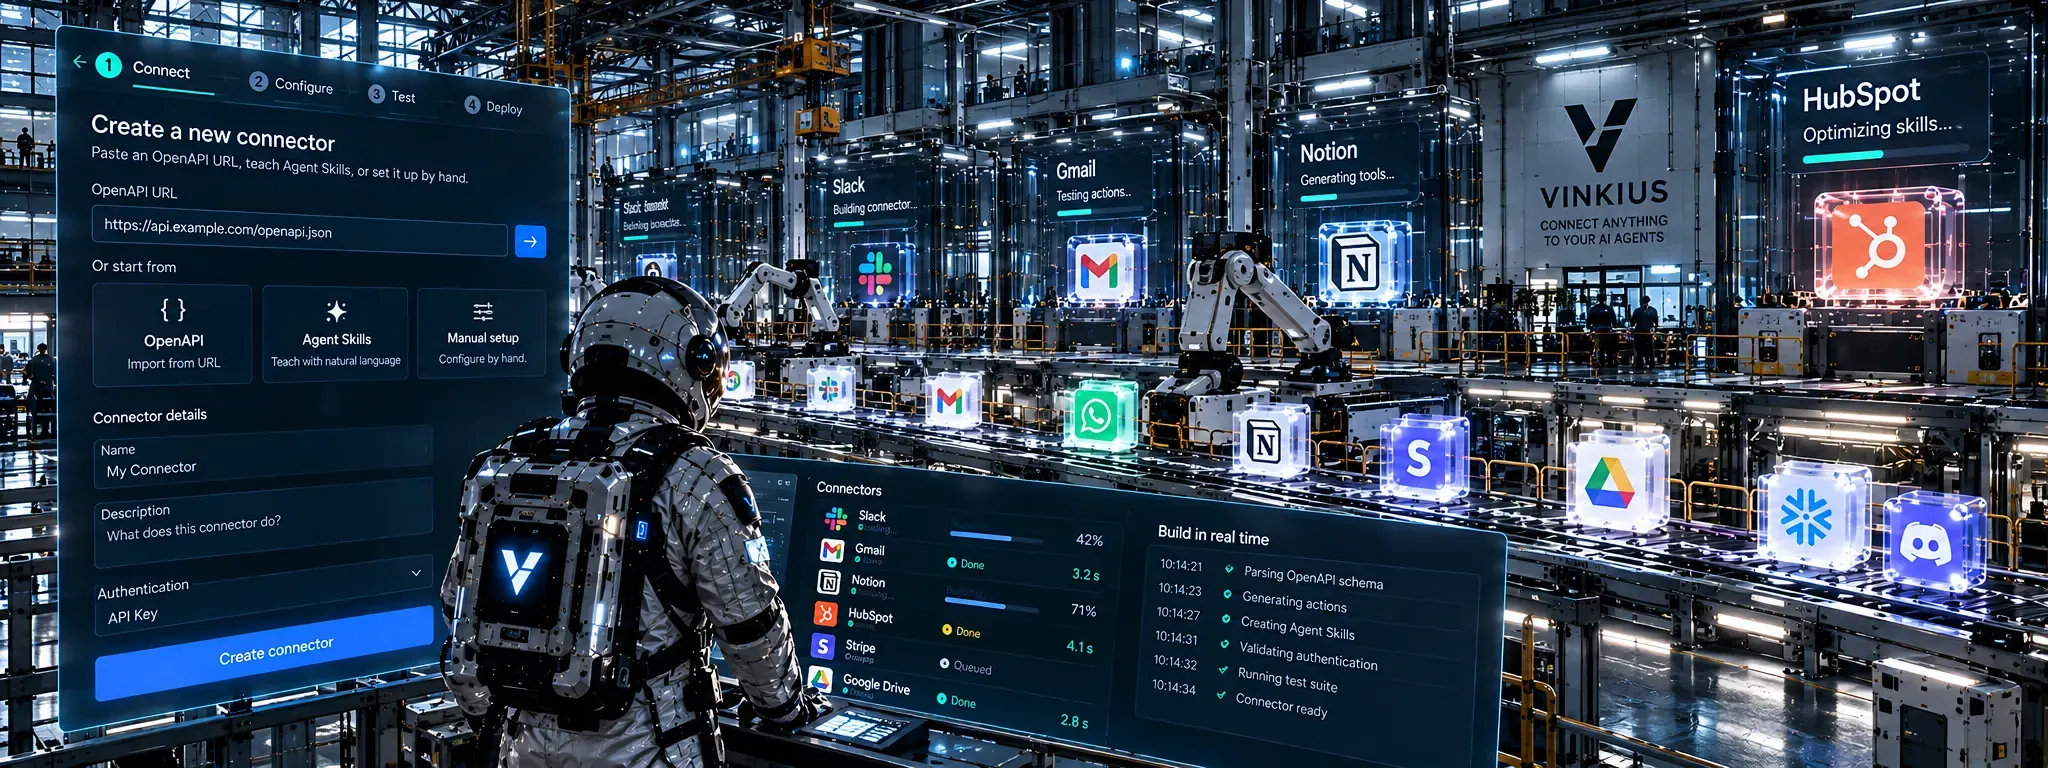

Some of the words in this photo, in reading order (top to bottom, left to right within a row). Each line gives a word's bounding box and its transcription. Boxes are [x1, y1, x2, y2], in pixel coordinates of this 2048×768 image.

[105, 58, 111, 71] 1
[133, 61, 190, 79] Connect
[255, 76, 262, 87] 2
[276, 78, 333, 95] Configure
[373, 89, 380, 99] 3
[392, 90, 415, 103] Test
[1804, 78, 1920, 112] HubSpot
[468, 99, 476, 110] 4
[487, 101, 522, 117] Deploy
[92, 114, 164, 138] Create
[171, 126, 181, 139] a
[189, 128, 231, 143] new
[237, 132, 335, 151] connector
[1804, 122, 1890, 144] Optimizing
[1301, 141, 1357, 163] Notion
[92, 146, 128, 160] Paste
[133, 152, 147, 161] an
[153, 150, 208, 165] OpenAPI
[213, 155, 241, 169] URL,
[246, 158, 279, 170] teach
[283, 160, 318, 174] Agent
[322, 163, 353, 177] Skills,
[358, 168, 369, 176] or
[373, 168, 389, 178] set
[393, 168, 400, 179] it
[404, 172, 418, 182] up
[422, 170, 435, 184] by
[439, 171, 468, 183] hand.
[1057, 159, 1095, 179] Gmail
[833, 176, 865, 194] Slack
[1301, 171, 1356, 186] Generating
[92, 183, 147, 198] OpenAPI
[153, 187, 177, 199] URL
[1057, 189, 1088, 202] Testing
[1540, 180, 1668, 208] VINKIUS
[834, 203, 865, 215] Building
[105, 218, 331, 240] https://api.example.com/openapi.json
[1540, 218, 1599, 231] CONNECT
[1602, 215, 1668, 228] ANYTHING
[1544, 235, 1560, 246] TO
[1564, 234, 1595, 245] YOUR
[1599, 234, 1610, 244] AI
[1614, 231, 1664, 244] AGENTS
[92, 260, 108, 271] Or
[113, 261, 143, 272] start
[147, 260, 176, 272] from
[144, 335, 203, 350] OpenAPI
[302, 333, 339, 348] Agent
[342, 333, 371, 347] Skills
[447, 332, 487, 343] Manual
[490, 333, 519, 345] setup
[128, 359, 165, 371] Import
[169, 358, 194, 368] from
[198, 357, 221, 368] URL
[271, 356, 300, 367] Teach
[303, 356, 322, 366] with
[325, 356, 357, 365] natural
[360, 356, 401, 367] language
[439, 354, 485, 366] Configure
[488, 354, 499, 365] by
[502, 353, 527, 363] hand.
[93, 412, 162, 424] Connector
[166, 408, 207, 421] details
[102, 445, 135, 456] Name
[108, 466, 126, 479] My
[131, 462, 196, 476] Connector
[817, 481, 882, 496] Connectors
[102, 505, 170, 520] Description
[859, 510, 886, 522] Slack
[107, 529, 139, 541] What
[143, 527, 172, 538] does
[175, 523, 196, 535] this
[199, 520, 257, 533] connector
[261, 515, 281, 527] do?
[1159, 525, 1191, 539] Build
[1195, 528, 1206, 540] in
[1211, 530, 1235, 543] real
[1239, 531, 1269, 546] time
[1076, 534, 1103, 546] 42%
[856, 543, 885, 555] Gmail
[961, 559, 984, 570] Done
[852, 575, 885, 587] Notion
[1073, 568, 1090, 580] 3.2
[1094, 573, 1099, 581] s
[1161, 559, 1201, 571] 10:14:21
[1245, 566, 1283, 582] Parsing
[1287, 570, 1335, 585] OpenAPI
[1339, 576, 1383, 590] schema
[98, 580, 188, 600] Authentication
[1159, 583, 1201, 596] 10:14:23
[1243, 591, 1302, 610] Generating
[1306, 600, 1347, 613] actions
[108, 611, 129, 624] API
[135, 609, 158, 622] Key
[848, 607, 893, 624] HubSpot
[1072, 604, 1096, 617] 71%
[1157, 607, 1200, 620] 10:14:27
[1242, 616, 1286, 634] Creating
[1290, 622, 1322, 636] Agent
[1326, 627, 1355, 640] Skills
[957, 627, 980, 638] Done
[220, 650, 264, 665] Create
[268, 637, 334, 657] connector
[846, 639, 875, 654] Stripe
[1067, 640, 1083, 652] 4.1
[1087, 645, 1093, 654] s
[1156, 630, 1197, 645] 10:14:31
[1240, 642, 1293, 661] Validating
[1296, 652, 1377, 671] authentication
[954, 660, 992, 675] Queued
[1154, 655, 1197, 670] 10:14:32
[1239, 667, 1282, 686] Running
[1285, 675, 1306, 688] test
[1310, 680, 1337, 693] suite
[843, 674, 881, 691] Google
[883, 681, 910, 695] Drive
[951, 695, 976, 708] Done
[1153, 679, 1195, 695] 10:14:34
[1236, 693, 1294, 711] Connector
[1297, 705, 1328, 720] ready
[1061, 714, 1079, 727] 2.8
[1082, 720, 1088, 729] s
